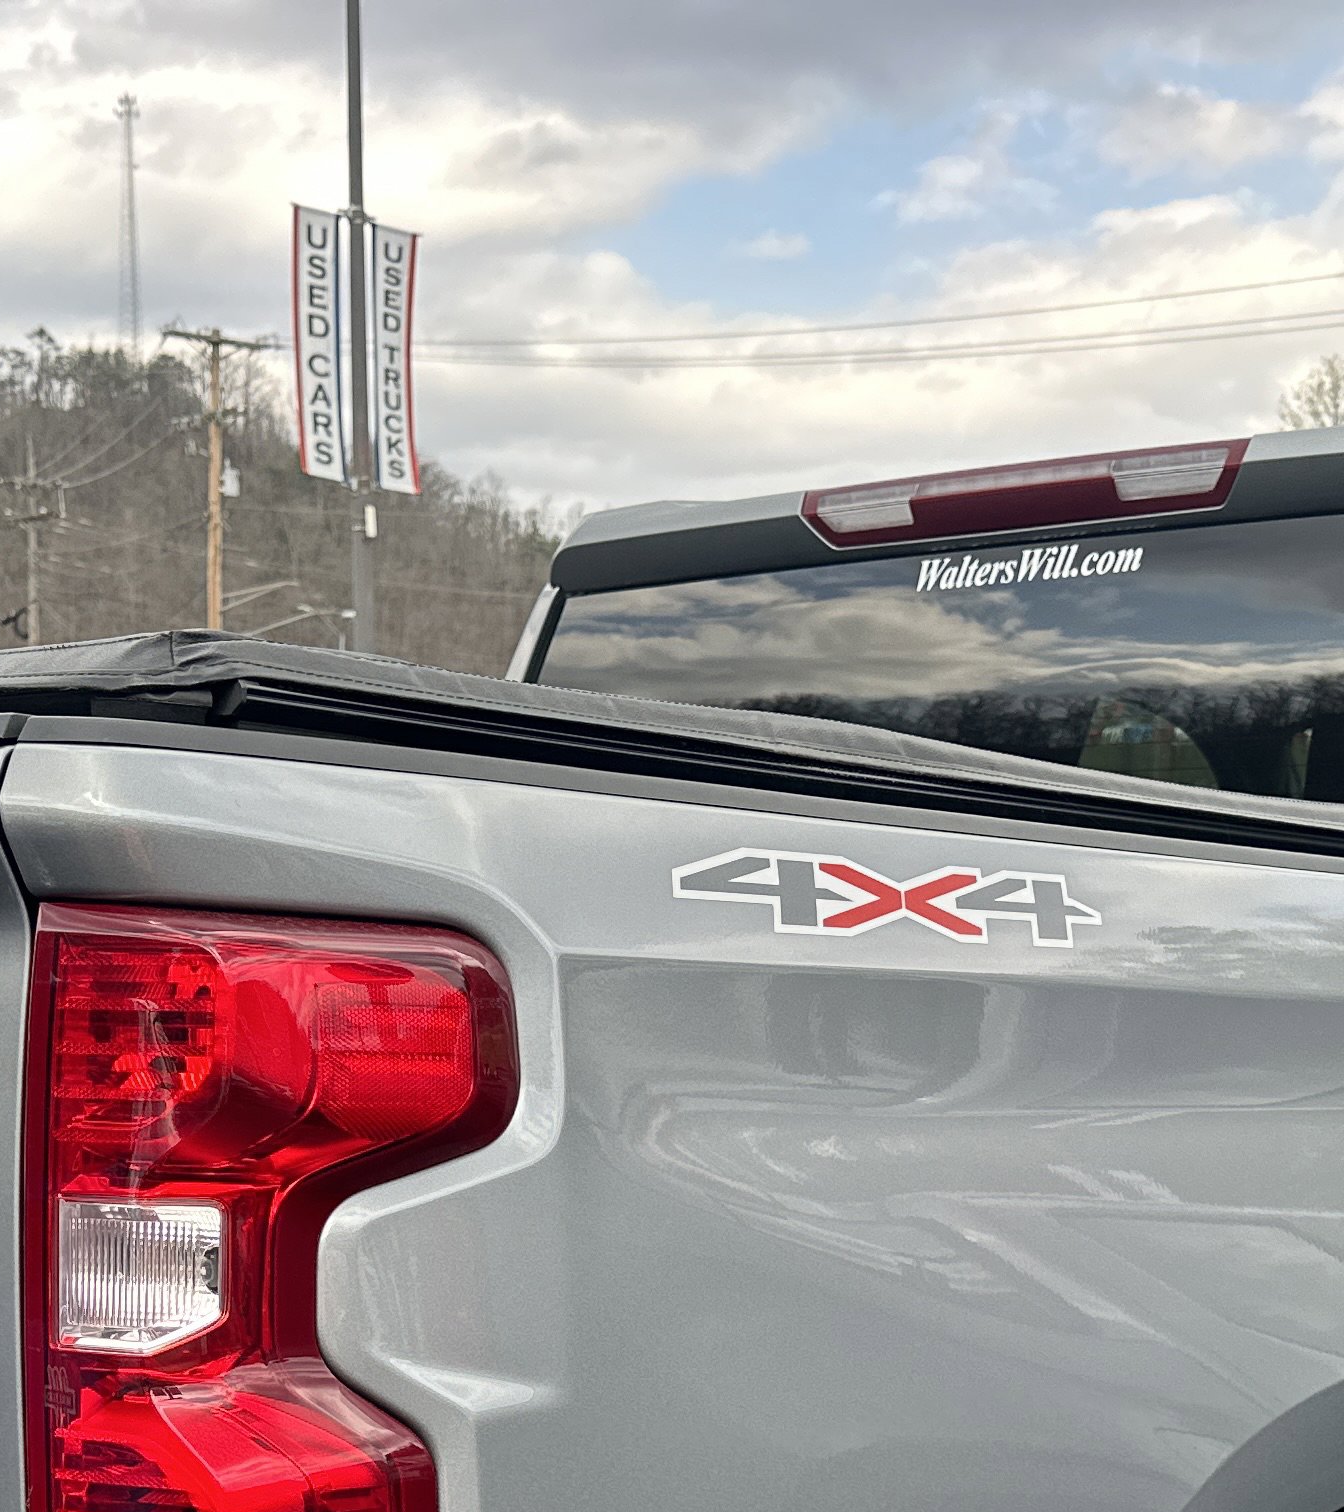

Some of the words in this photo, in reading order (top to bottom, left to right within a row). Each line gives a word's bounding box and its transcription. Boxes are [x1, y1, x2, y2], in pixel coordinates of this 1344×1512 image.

[306, 223, 329, 338] USED
[383, 243, 403, 334] USED
[308, 353, 334, 466] CARS
[382, 345, 404, 480] TRUCKS
[915, 543, 1144, 593] WaltersWill.com
